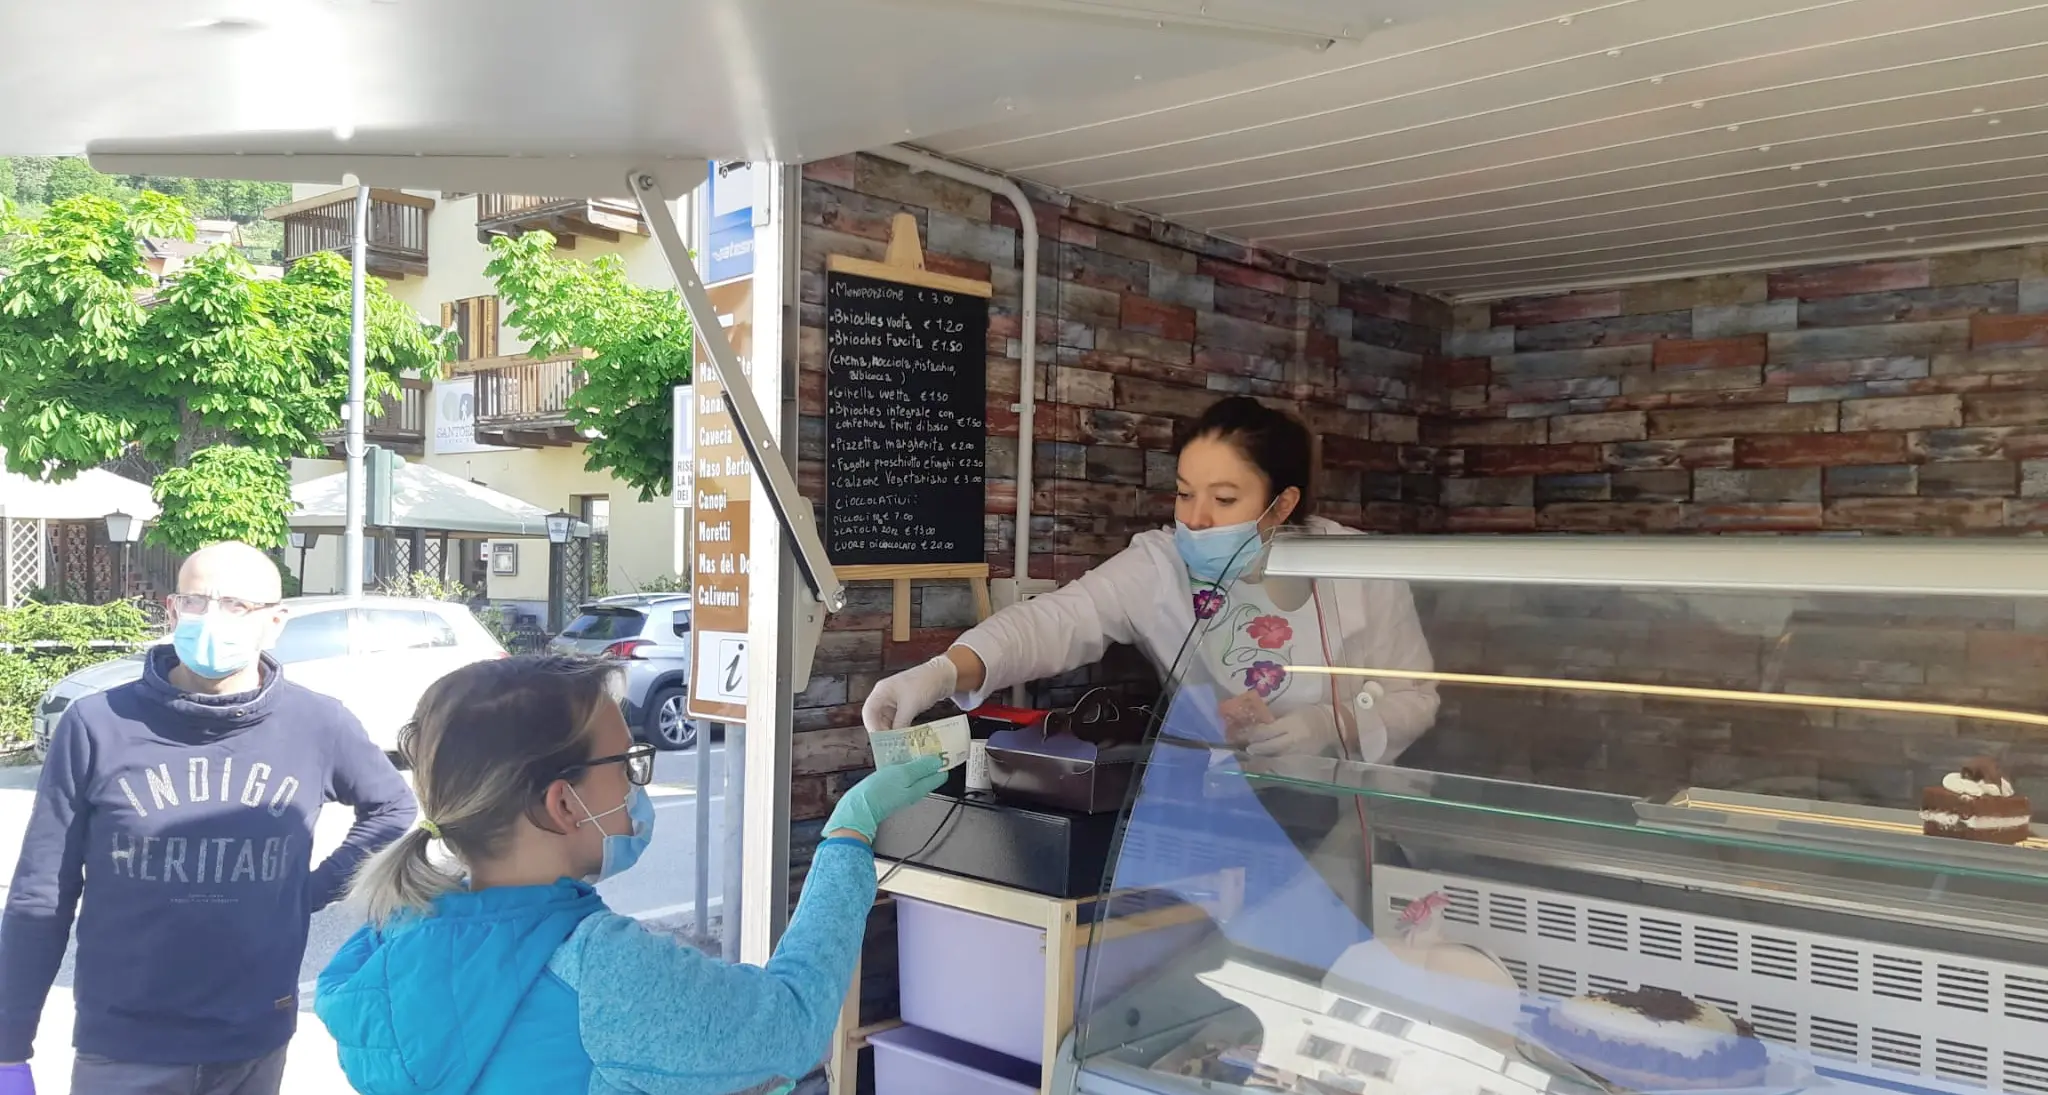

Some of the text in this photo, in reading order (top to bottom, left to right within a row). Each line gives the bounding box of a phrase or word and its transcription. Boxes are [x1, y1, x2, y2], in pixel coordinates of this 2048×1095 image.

[938, 410, 954, 420] con
[835, 436, 881, 451] Pizzetta
[885, 437, 945, 453] margherita
[699, 457, 721, 478] Maso
[698, 489, 727, 512] Canopi
[699, 520, 731, 541] Moretti
[699, 552, 716, 574] Mas
[720, 552, 735, 574] del
[698, 585, 739, 607] Caliverni
[118, 757, 299, 817] INDIGO
